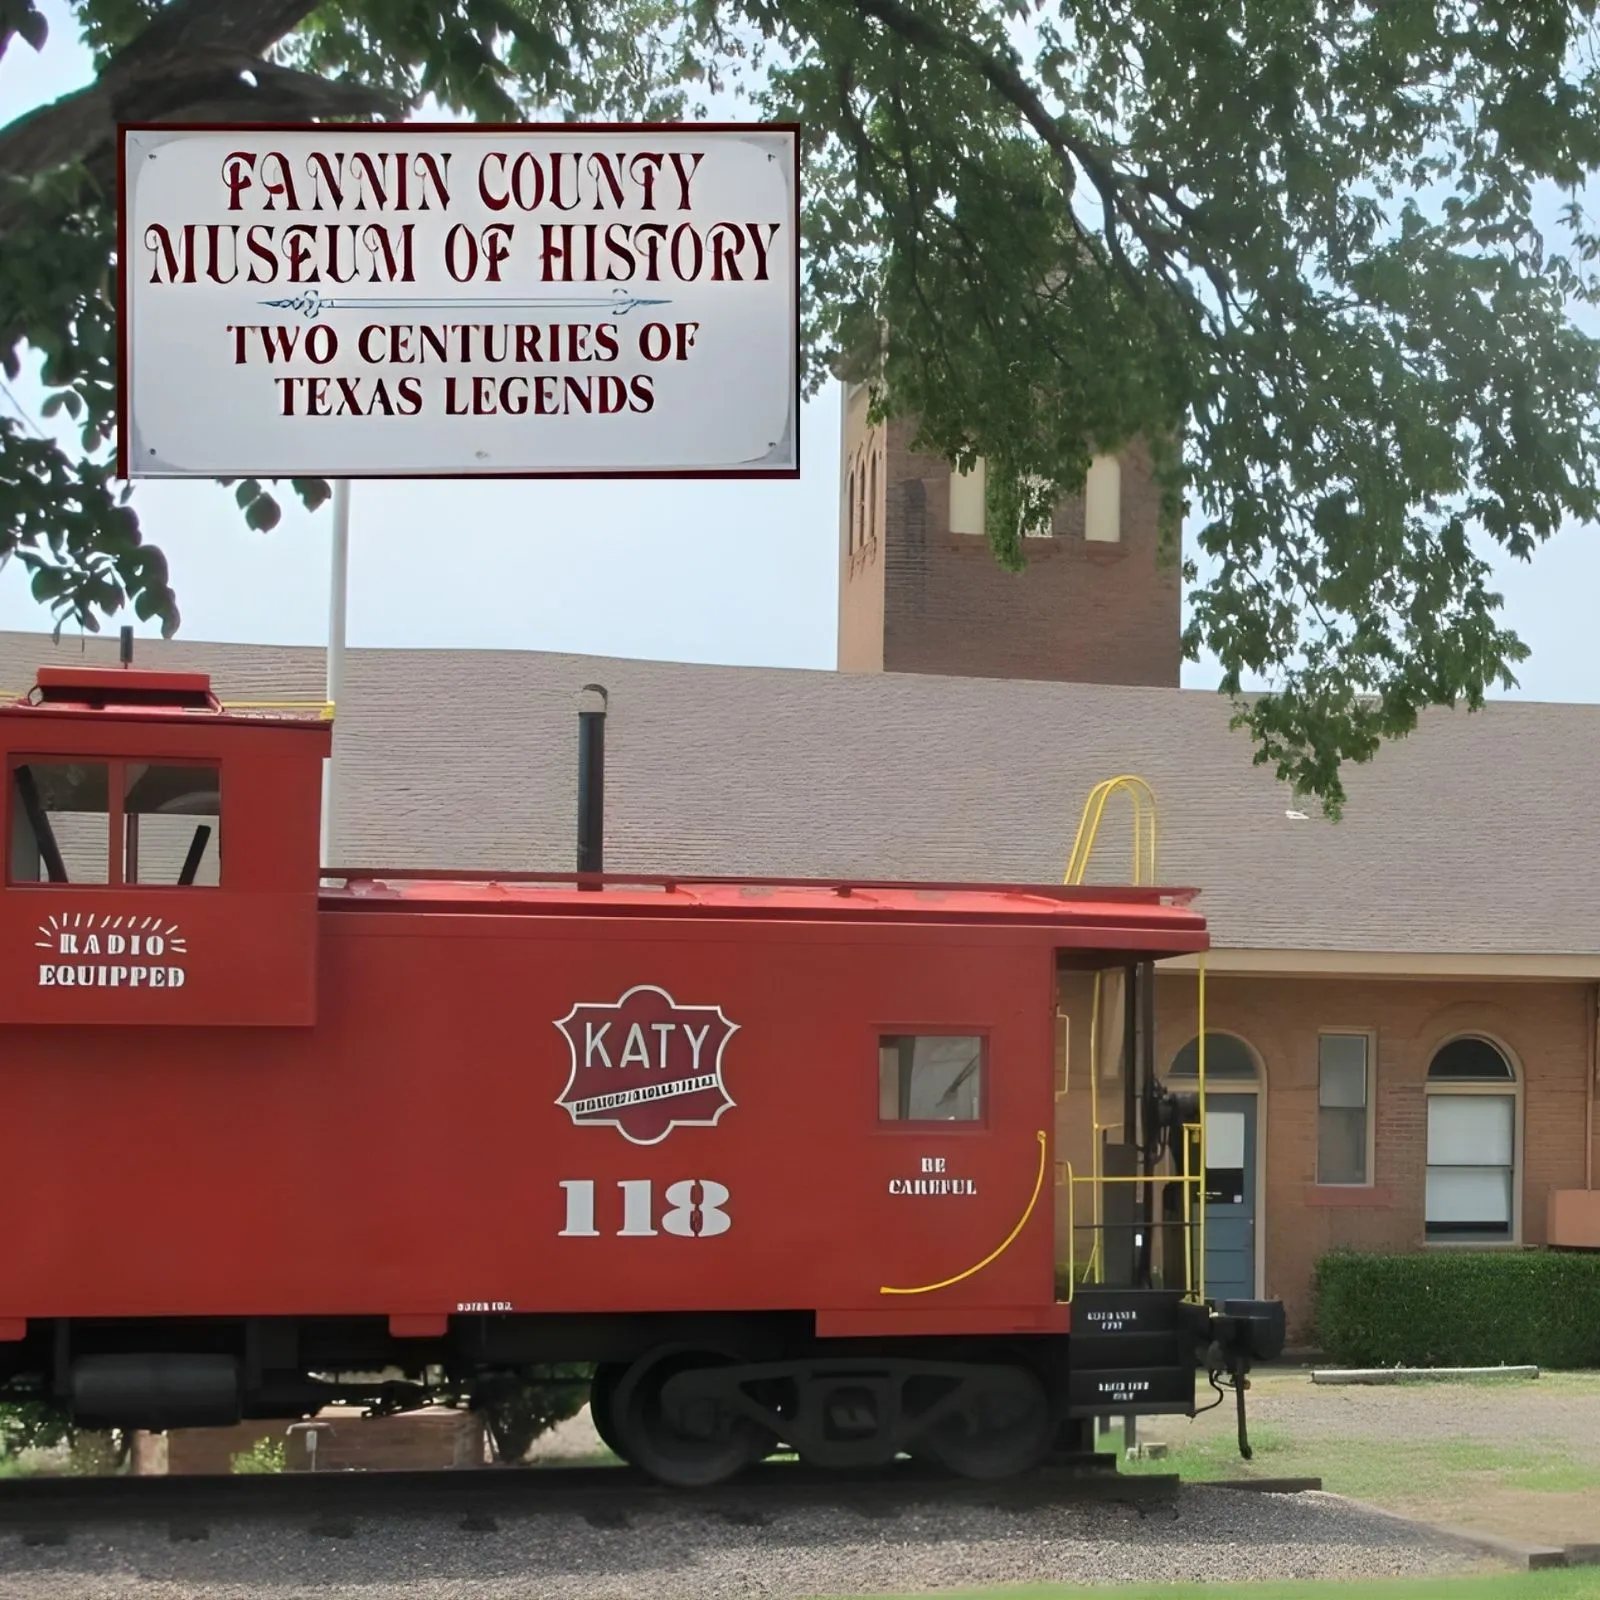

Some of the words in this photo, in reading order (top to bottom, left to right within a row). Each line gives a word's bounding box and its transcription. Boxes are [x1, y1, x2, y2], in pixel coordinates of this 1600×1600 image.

[222, 151, 452, 211] FANNIN
[478, 151, 704, 211] COUNTY
[144, 223, 415, 284] MUSEUM
[444, 223, 514, 282] OF
[539, 222, 780, 282] HISTORY
[227, 324, 338, 364] TWO
[359, 323, 619, 363] CENTURIES
[639, 321, 699, 361] OF
[274, 376, 422, 417] TEXAS
[445, 375, 655, 415] LEGENDS
[59, 933, 165, 956] RADIO
[38, 964, 185, 987] EQUIPPED
[585, 1022, 710, 1069] KATY
[557, 1179, 732, 1238] 118
